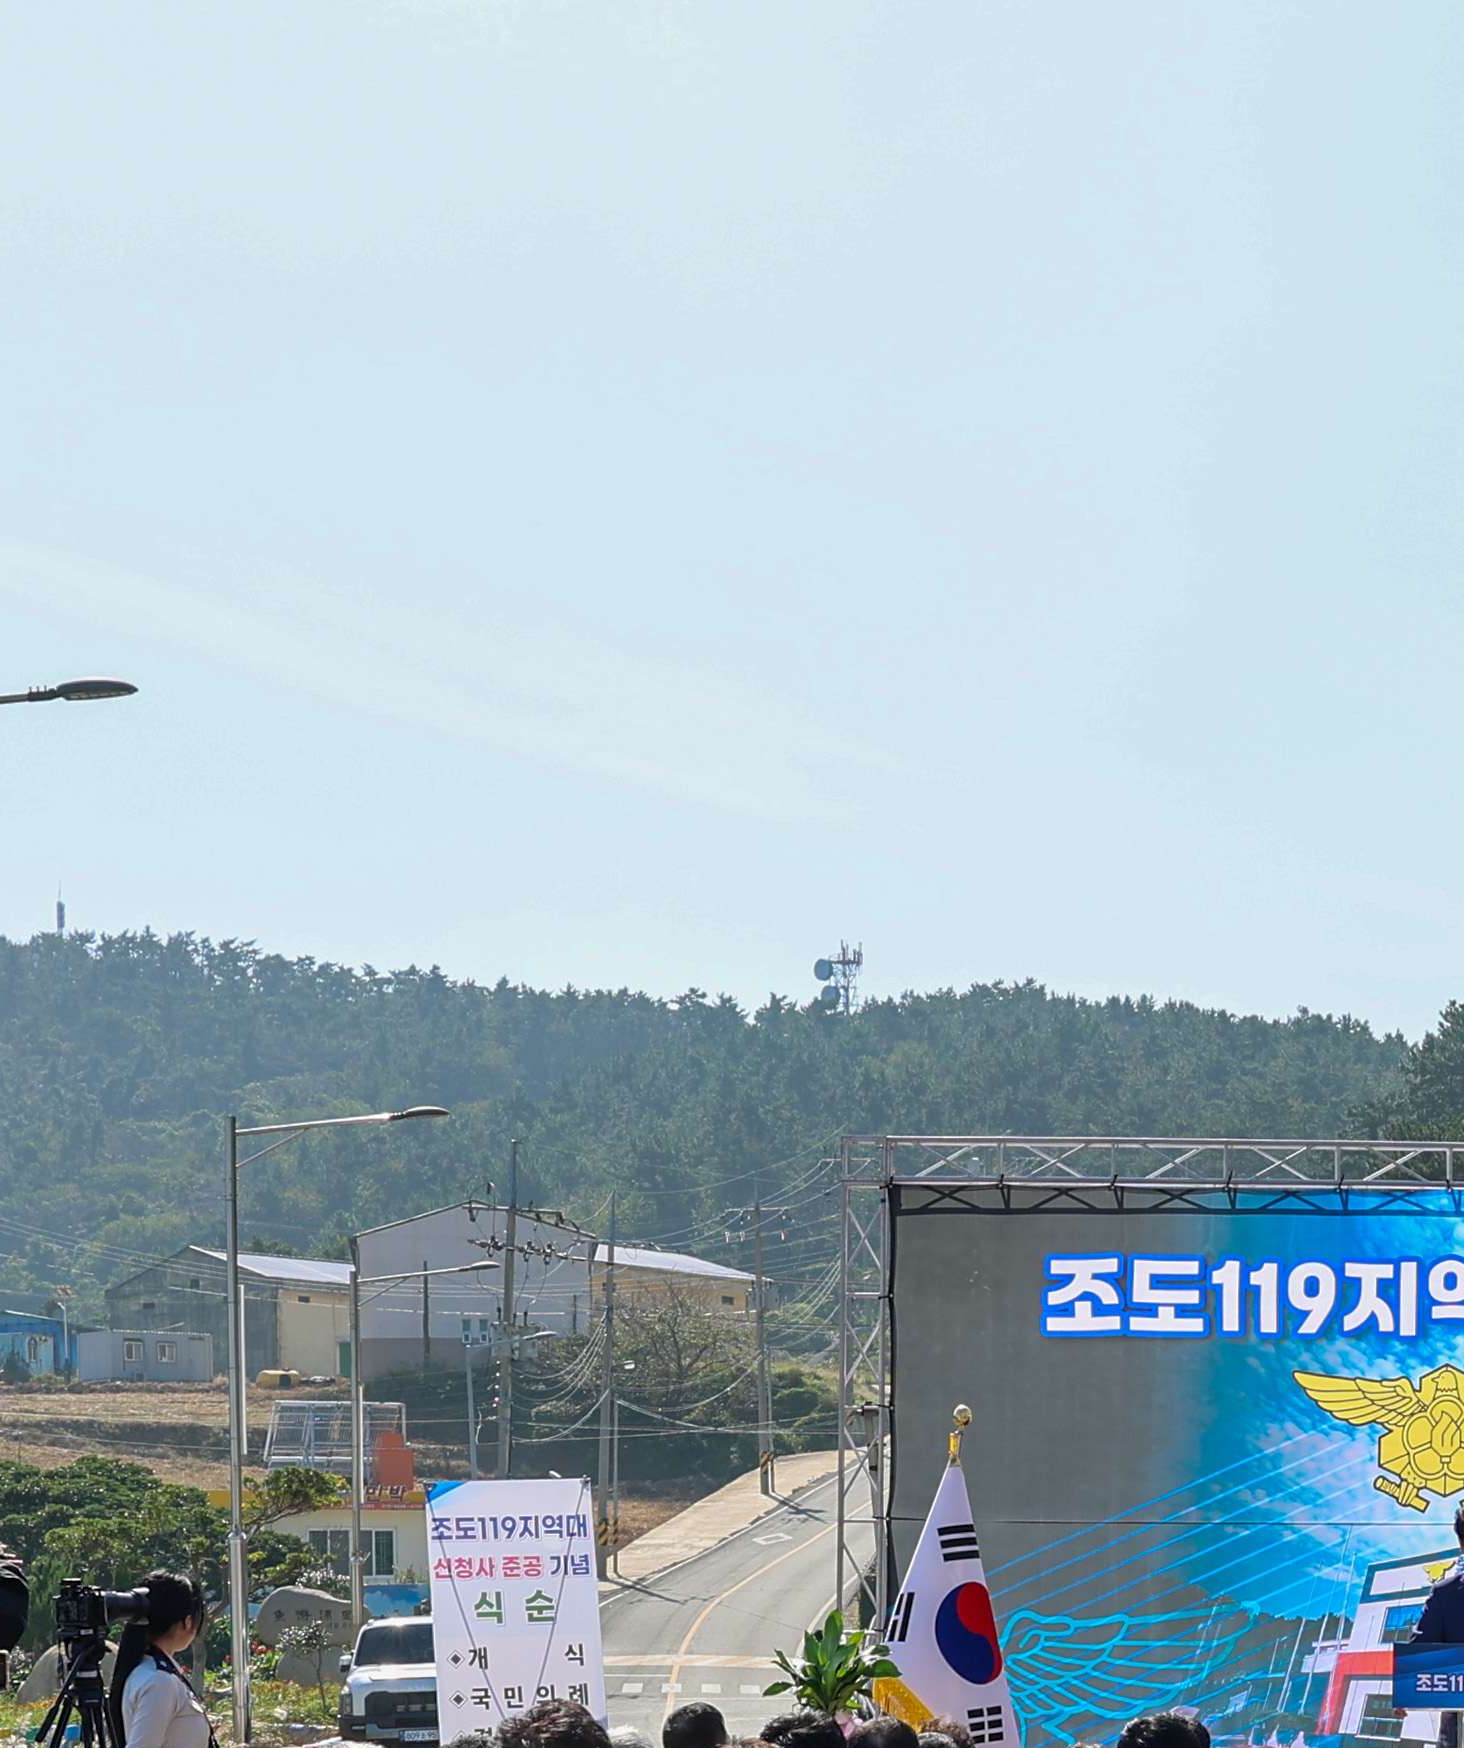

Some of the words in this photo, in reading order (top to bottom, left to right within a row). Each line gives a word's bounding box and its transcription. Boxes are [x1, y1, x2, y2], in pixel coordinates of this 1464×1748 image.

[430, 1513, 588, 1541] 조도119지역대
[433, 1556, 495, 1579] 신청사
[501, 1555, 543, 1578] 준공
[549, 1553, 591, 1577] 기념
